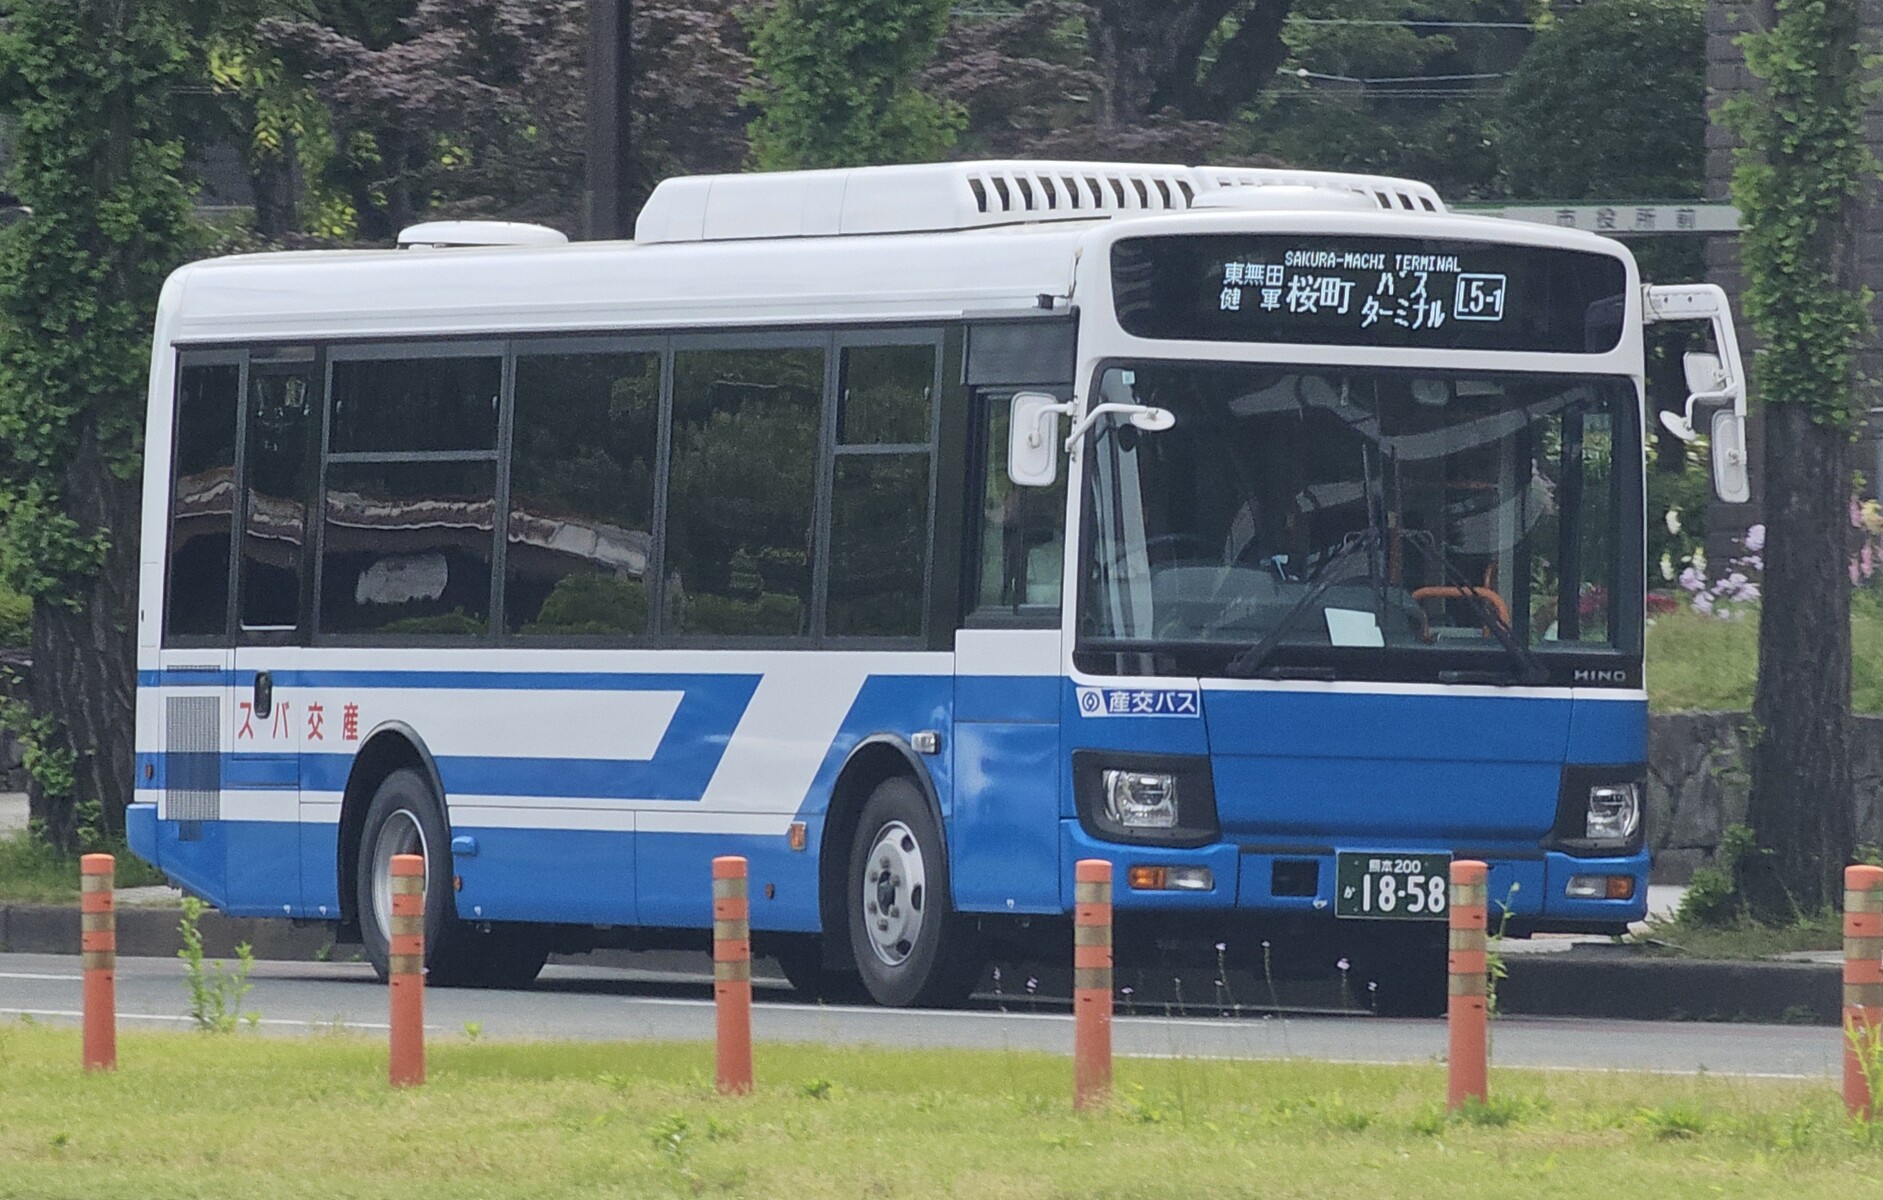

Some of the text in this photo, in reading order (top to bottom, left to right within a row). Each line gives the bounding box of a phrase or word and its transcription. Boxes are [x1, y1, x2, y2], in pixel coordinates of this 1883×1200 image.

[1555, 208, 1697, 230] 市役所前
[1222, 261, 1284, 287] 東無田
[1284, 250, 1462, 273] SAKURA-MACHI TERMINAL
[1285, 274, 1356, 315] 桜町
[1376, 270, 1428, 299] バス
[1457, 280, 1502, 313] L5-1
[1360, 295, 1446, 330] ターミナル
[1573, 669, 1627, 682] HINO
[1108, 690, 1196, 713] 産交バス
[1362, 873, 1446, 913] 18-58
